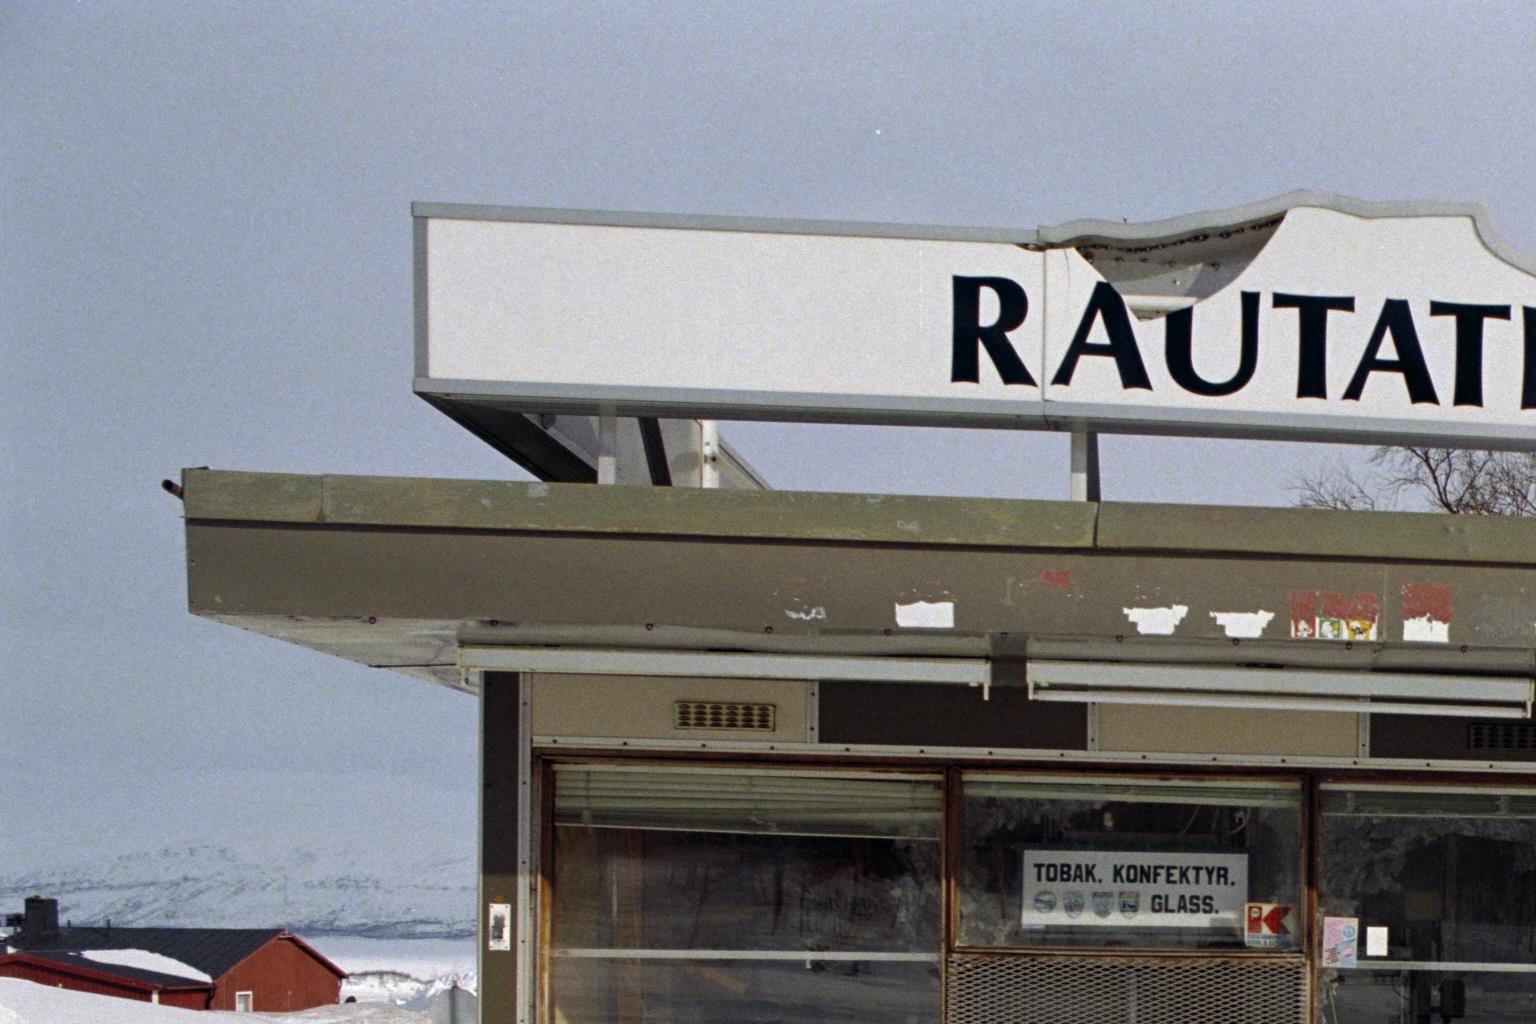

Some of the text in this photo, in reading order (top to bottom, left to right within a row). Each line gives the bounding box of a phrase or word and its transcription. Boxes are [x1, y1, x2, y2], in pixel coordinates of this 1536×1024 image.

[1033, 863, 1236, 887] TOBAK. KONFEKTYR.
[1151, 893, 1220, 915] GLASS.
